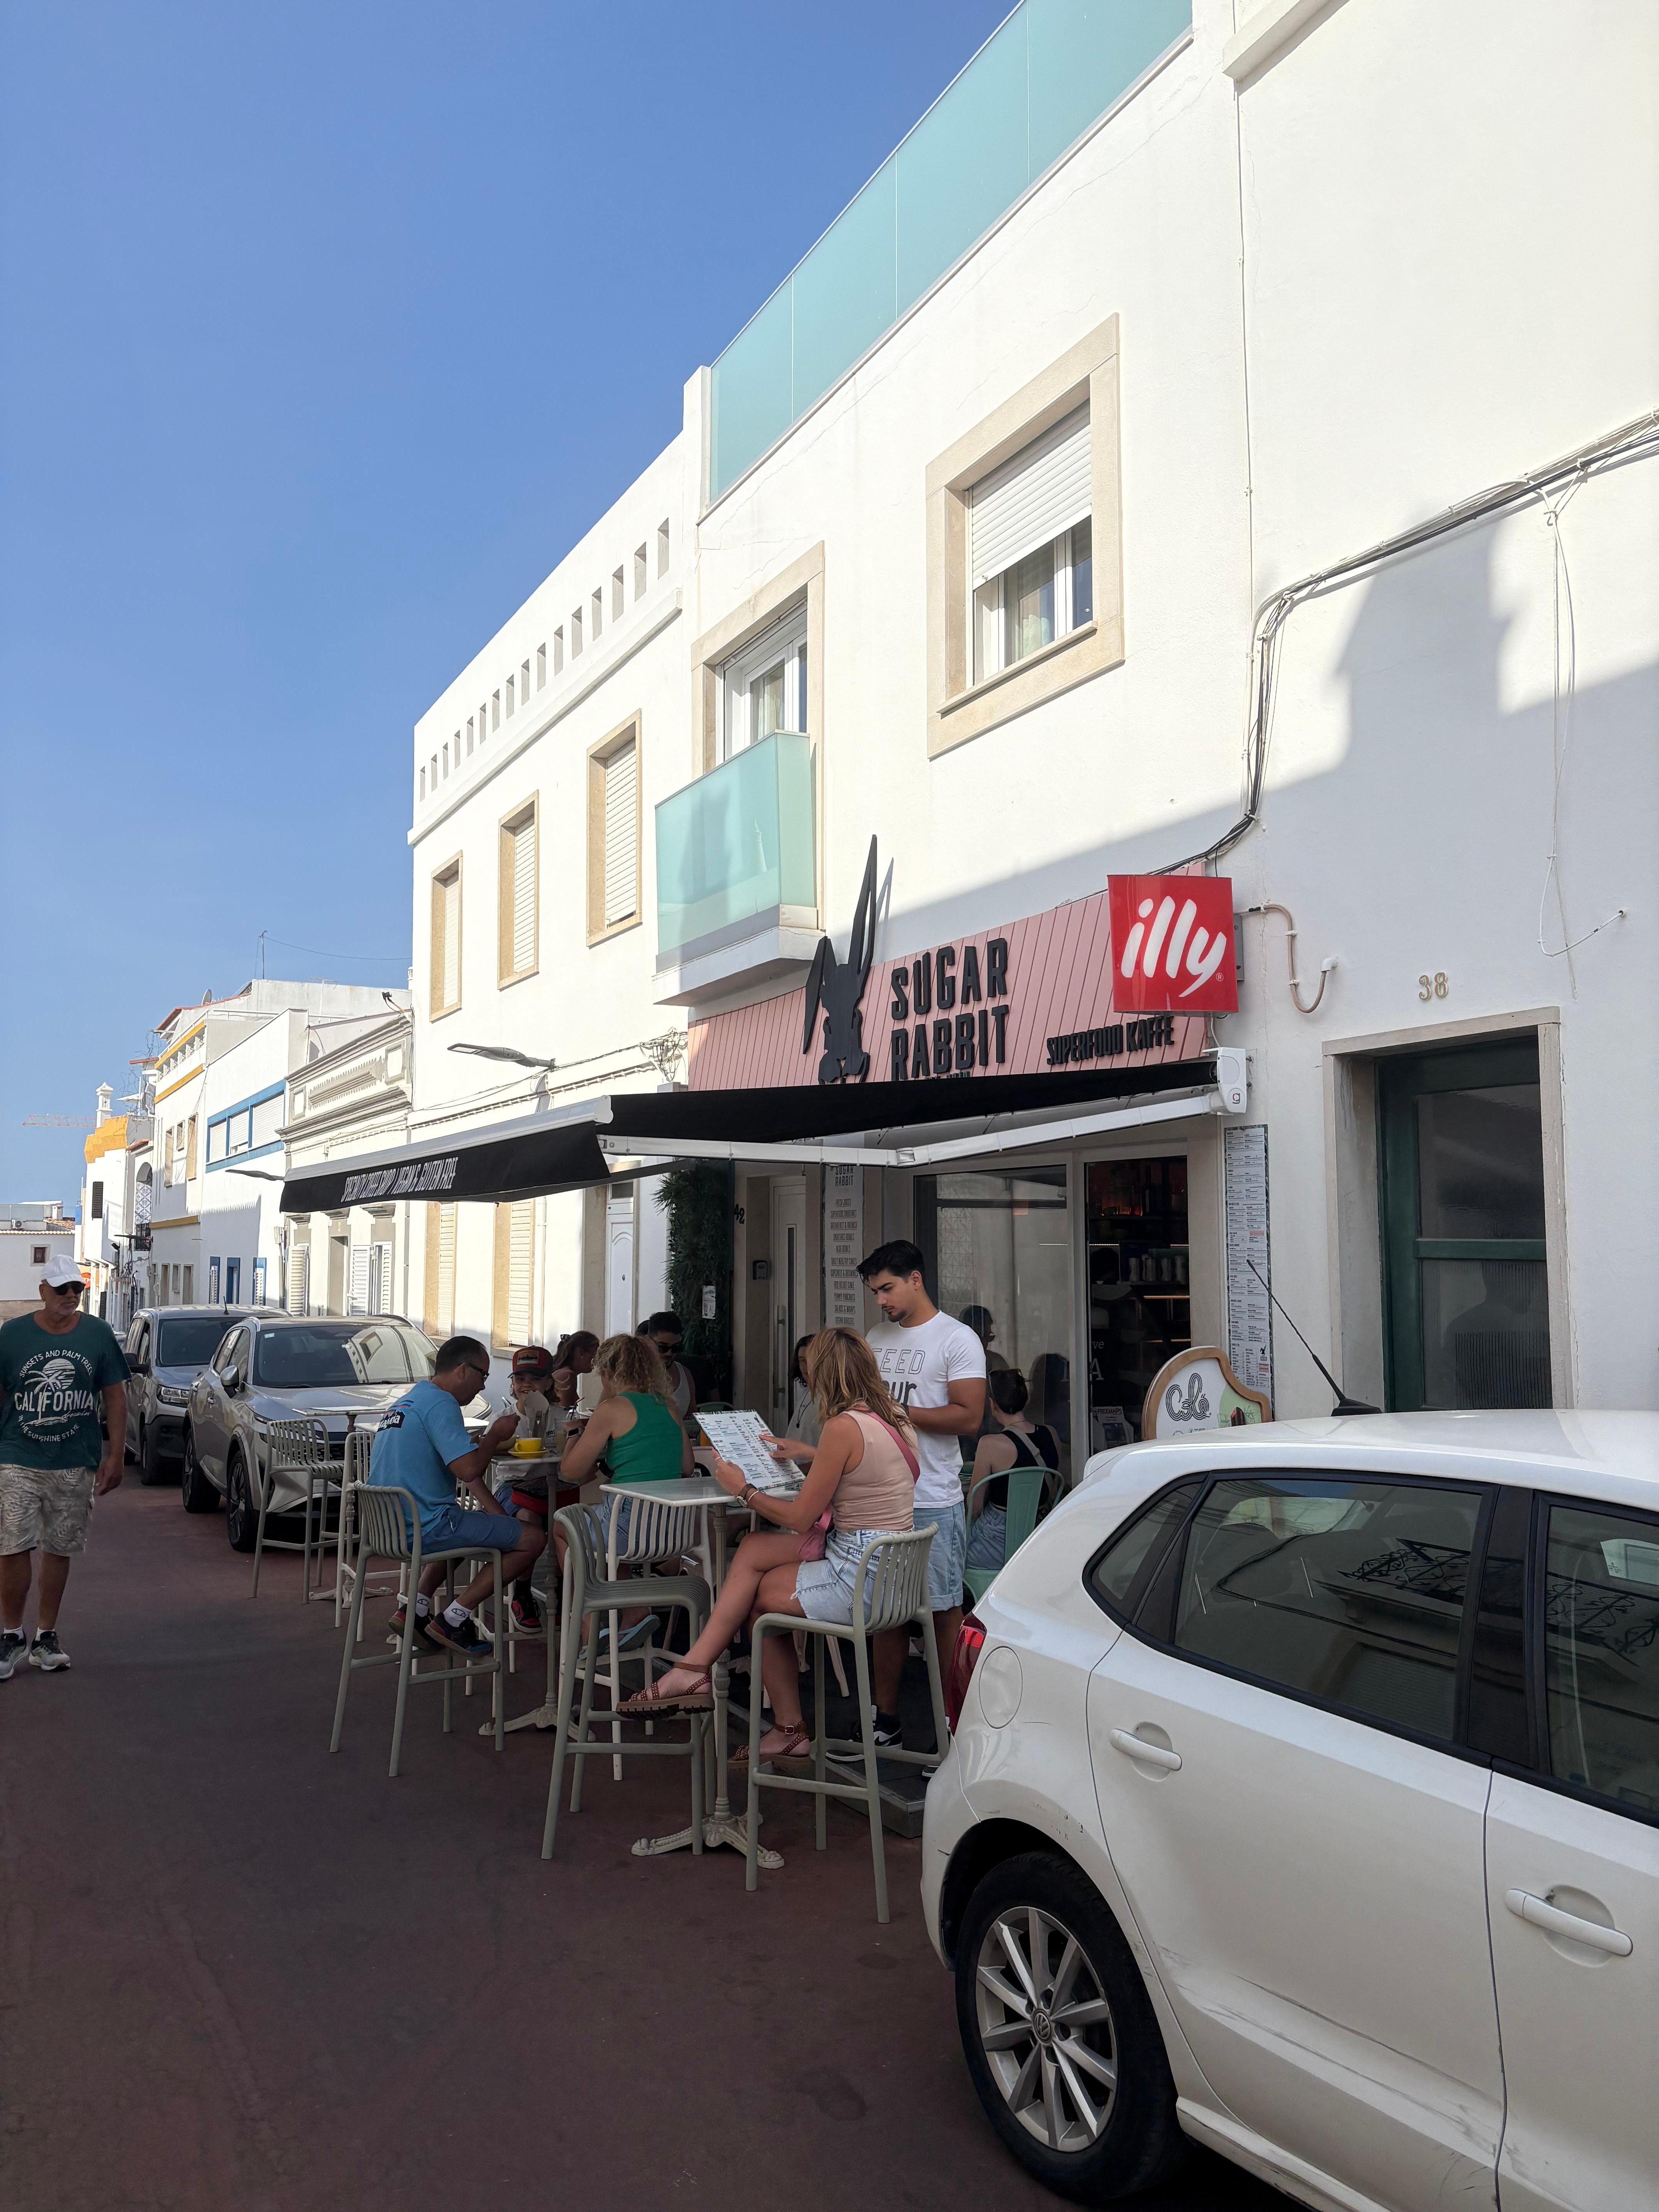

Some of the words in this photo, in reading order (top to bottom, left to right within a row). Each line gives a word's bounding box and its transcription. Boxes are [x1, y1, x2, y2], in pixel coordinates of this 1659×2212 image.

[1121, 895, 1227, 998] illy
[891, 938, 1008, 1020] SUGAR
[1419, 972, 1449, 1001] 38
[891, 1005, 1009, 1081] RABBIT
[1046, 1024, 1123, 1065] SUPERFOOD
[1126, 1016, 1175, 1052] KAFFE
[359, 1170, 383, 1199] COFFEE
[373, 1168, 396, 1197] SHOP
[391, 1164, 417, 1194] VEGAN
[408, 1163, 421, 1192] &
[415, 1159, 445, 1192] GLUTEN
[436, 1156, 459, 1189] FREE
[835, 1166, 854, 1175] SUGAR
[835, 1175, 854, 1187] RABBIT
[734, 1204, 745, 1224] 42
[19, 1353, 44, 1378] SUNSETS
[45, 1350, 60, 1358] AND
[62, 1349, 81, 1360] PALM
[14, 1390, 94, 1412] CALIFORNIA
[26, 1431, 61, 1442] SUNSHINE
